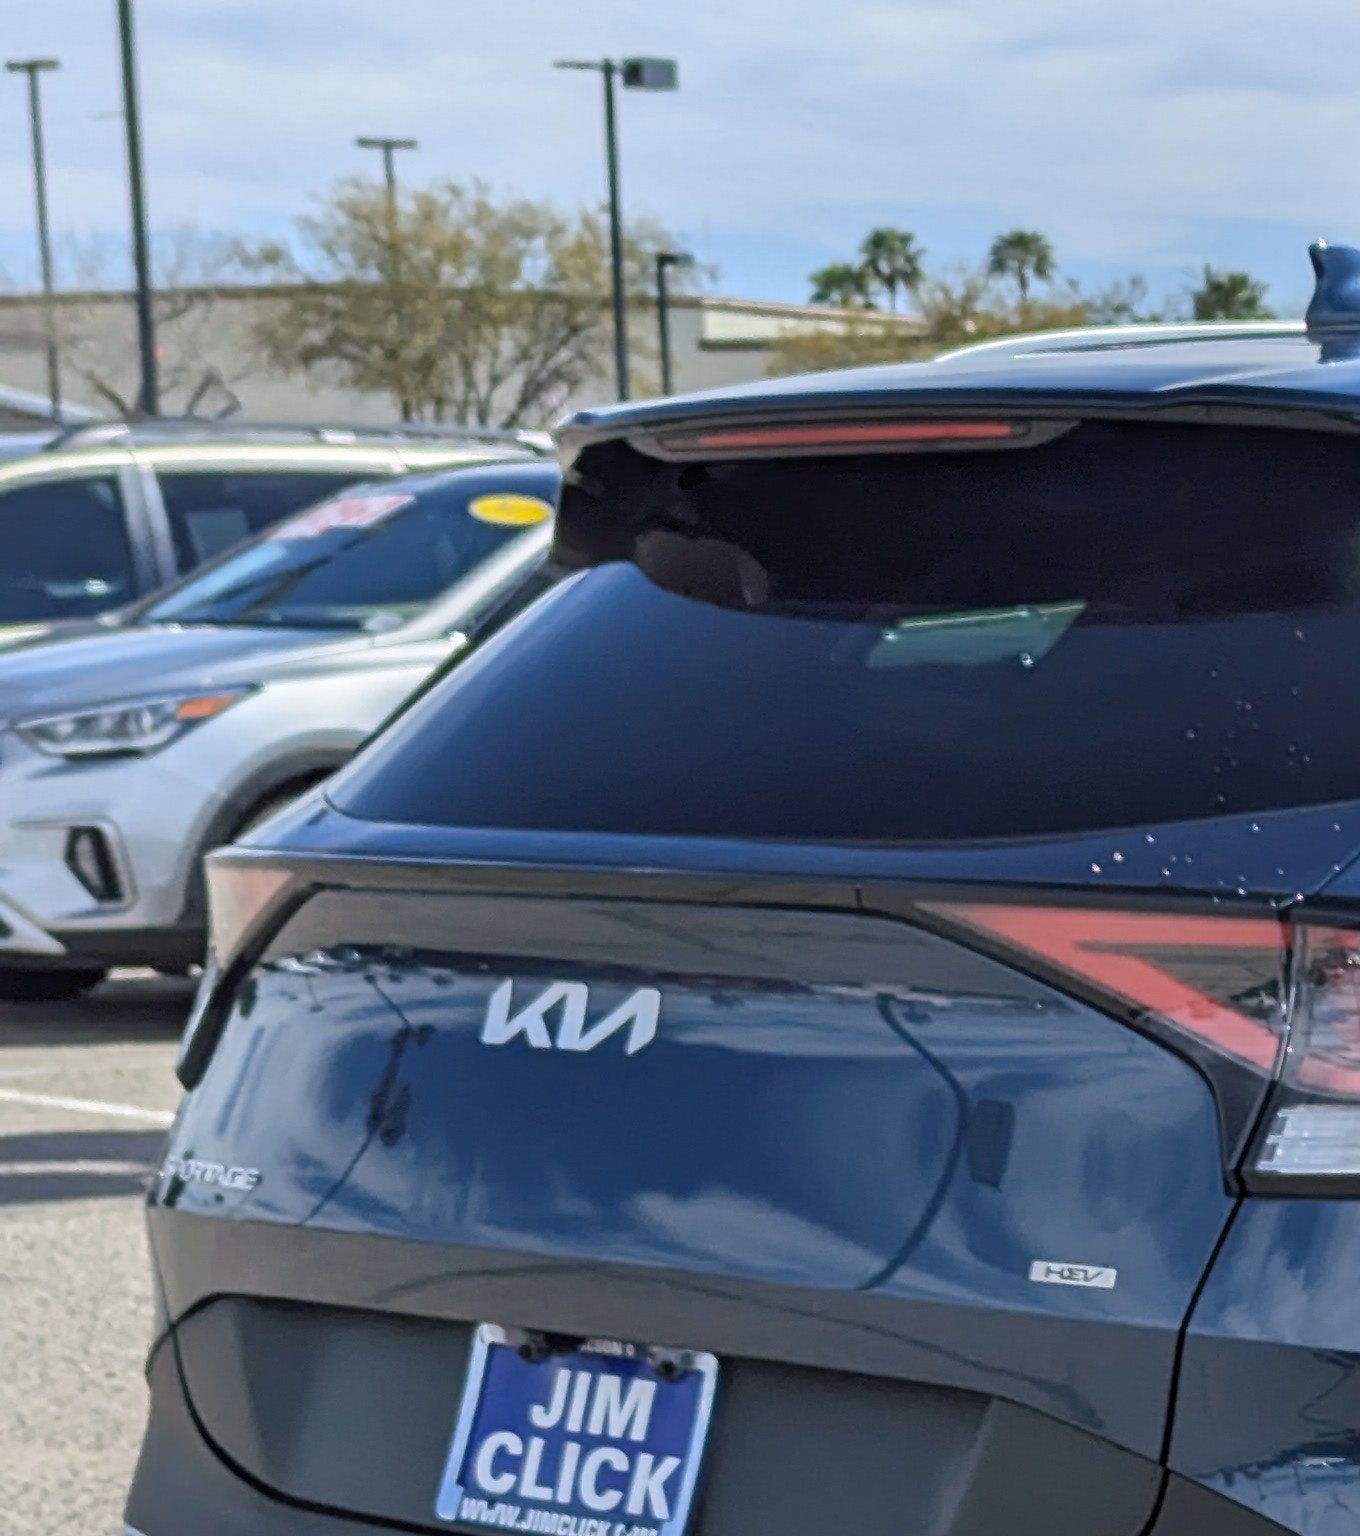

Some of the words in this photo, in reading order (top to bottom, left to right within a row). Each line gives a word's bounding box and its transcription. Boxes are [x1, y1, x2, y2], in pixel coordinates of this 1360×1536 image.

[480, 976, 662, 1056] KIA
[1044, 1265, 1105, 1283] HEV
[529, 1367, 658, 1443] JIM
[475, 1430, 682, 1521] CLICK
